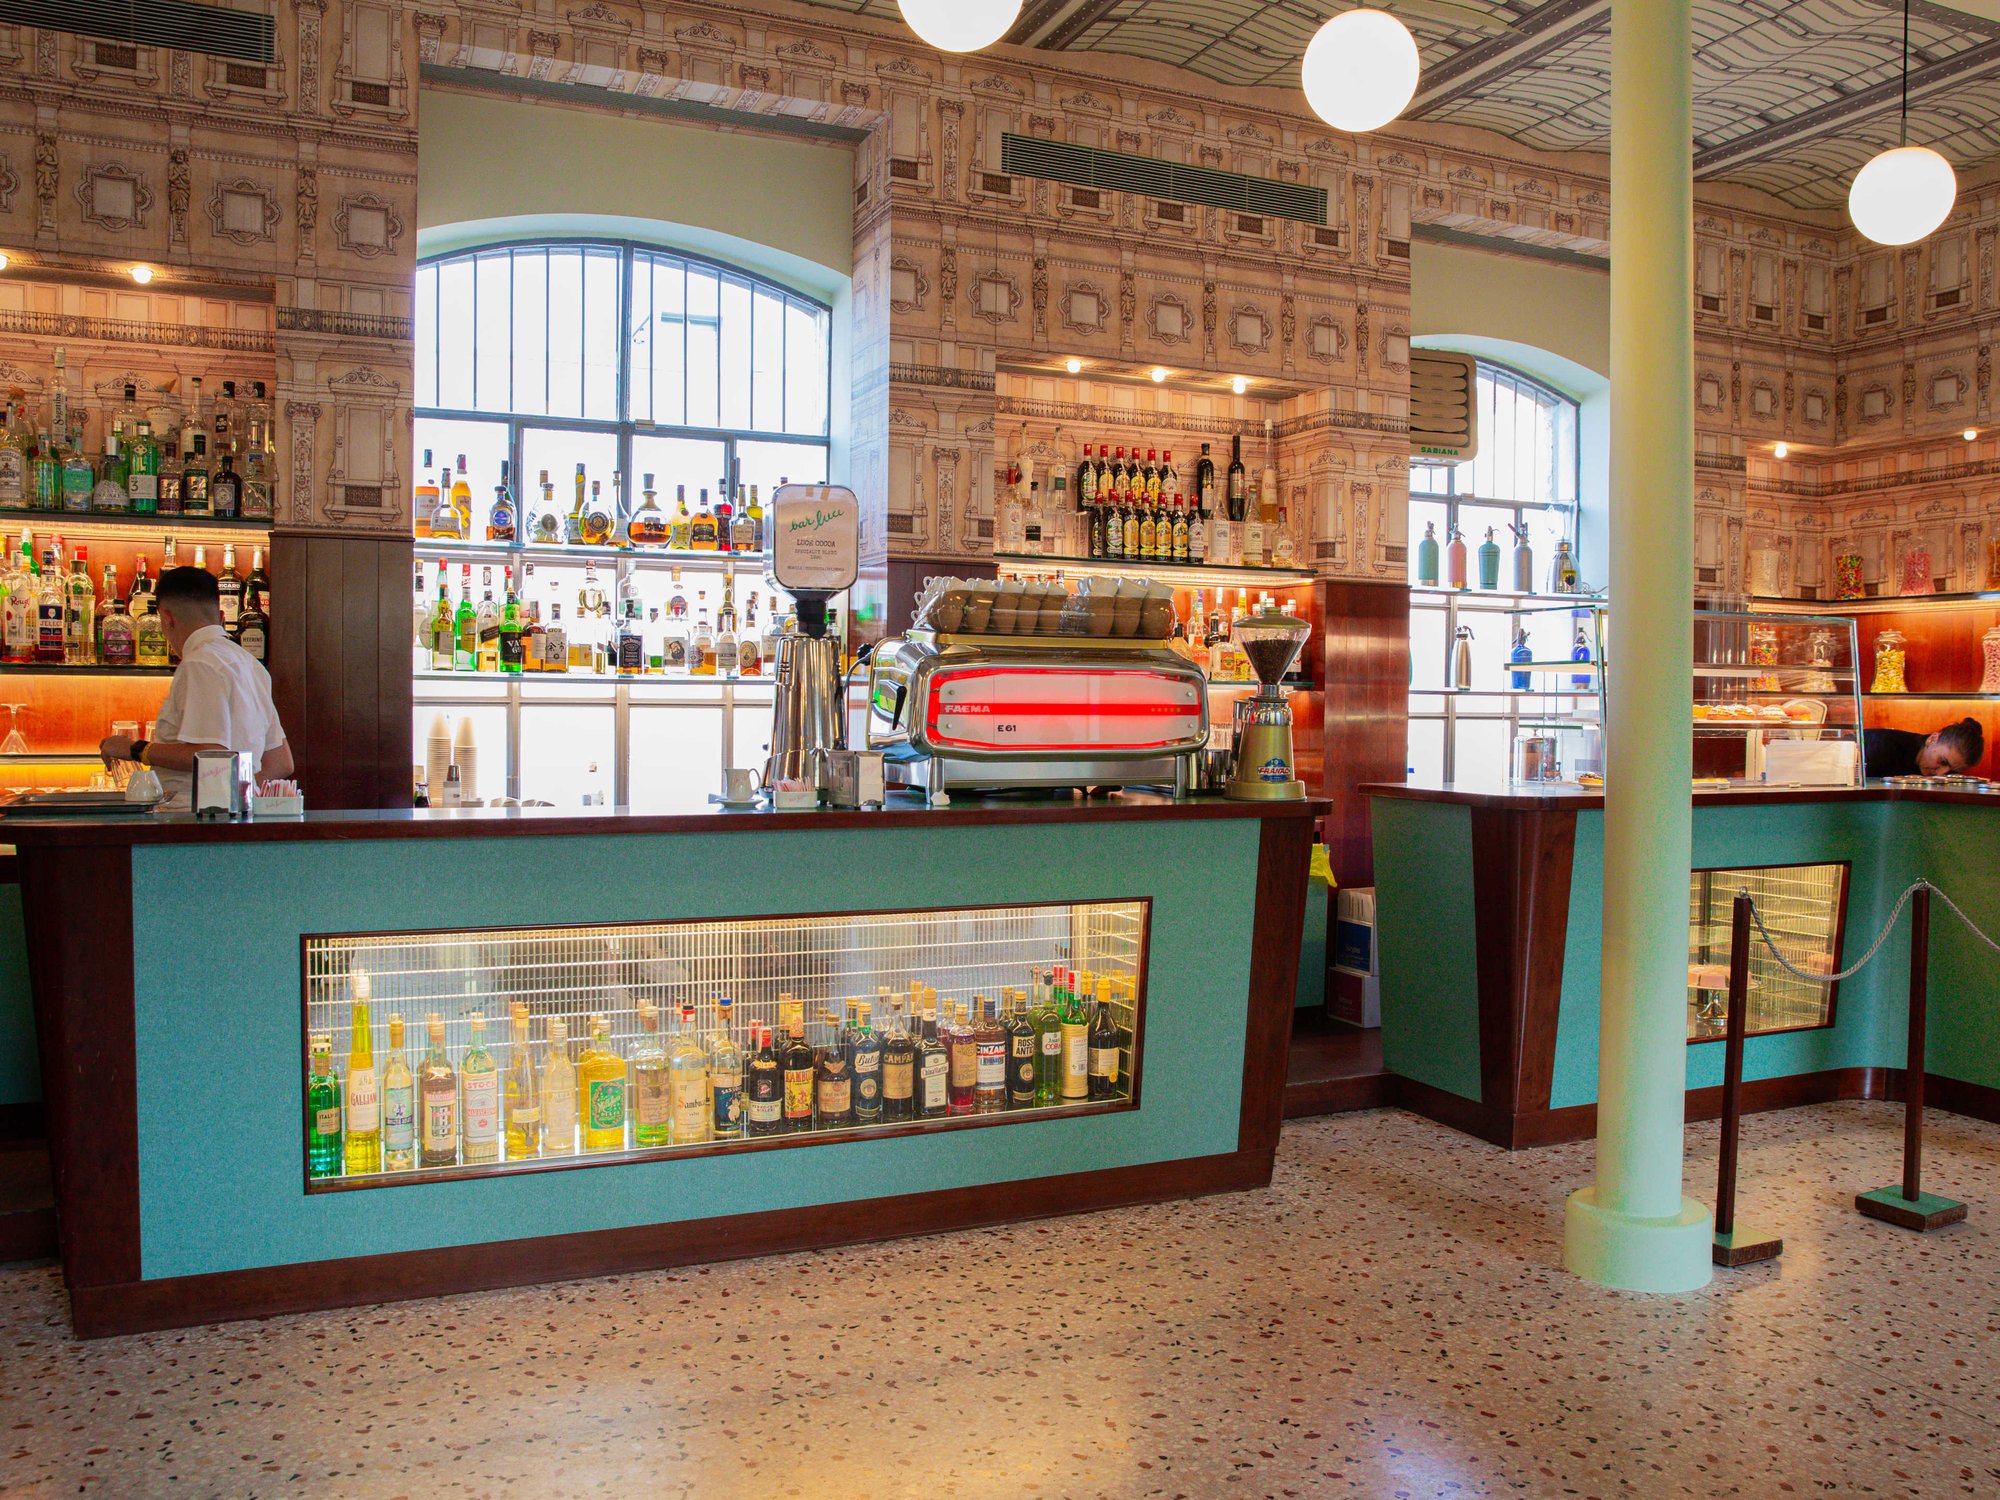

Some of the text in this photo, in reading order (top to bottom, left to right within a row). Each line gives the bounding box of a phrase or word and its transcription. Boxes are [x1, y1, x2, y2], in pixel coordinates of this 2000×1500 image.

[1420, 446, 1459, 456] SABIANA
[131, 480, 139, 491] 3
[789, 518, 815, 533] bar
[796, 539, 836, 548] LUCE COCOA
[944, 705, 991, 713] FAEMA
[1017, 1038, 1035, 1047] ROSS
[976, 1045, 1006, 1055] CINZAN
[1016, 1046, 1034, 1055] ANTI
[467, 1081, 496, 1089] STOCK
[351, 1092, 377, 1107] GALLIAN
